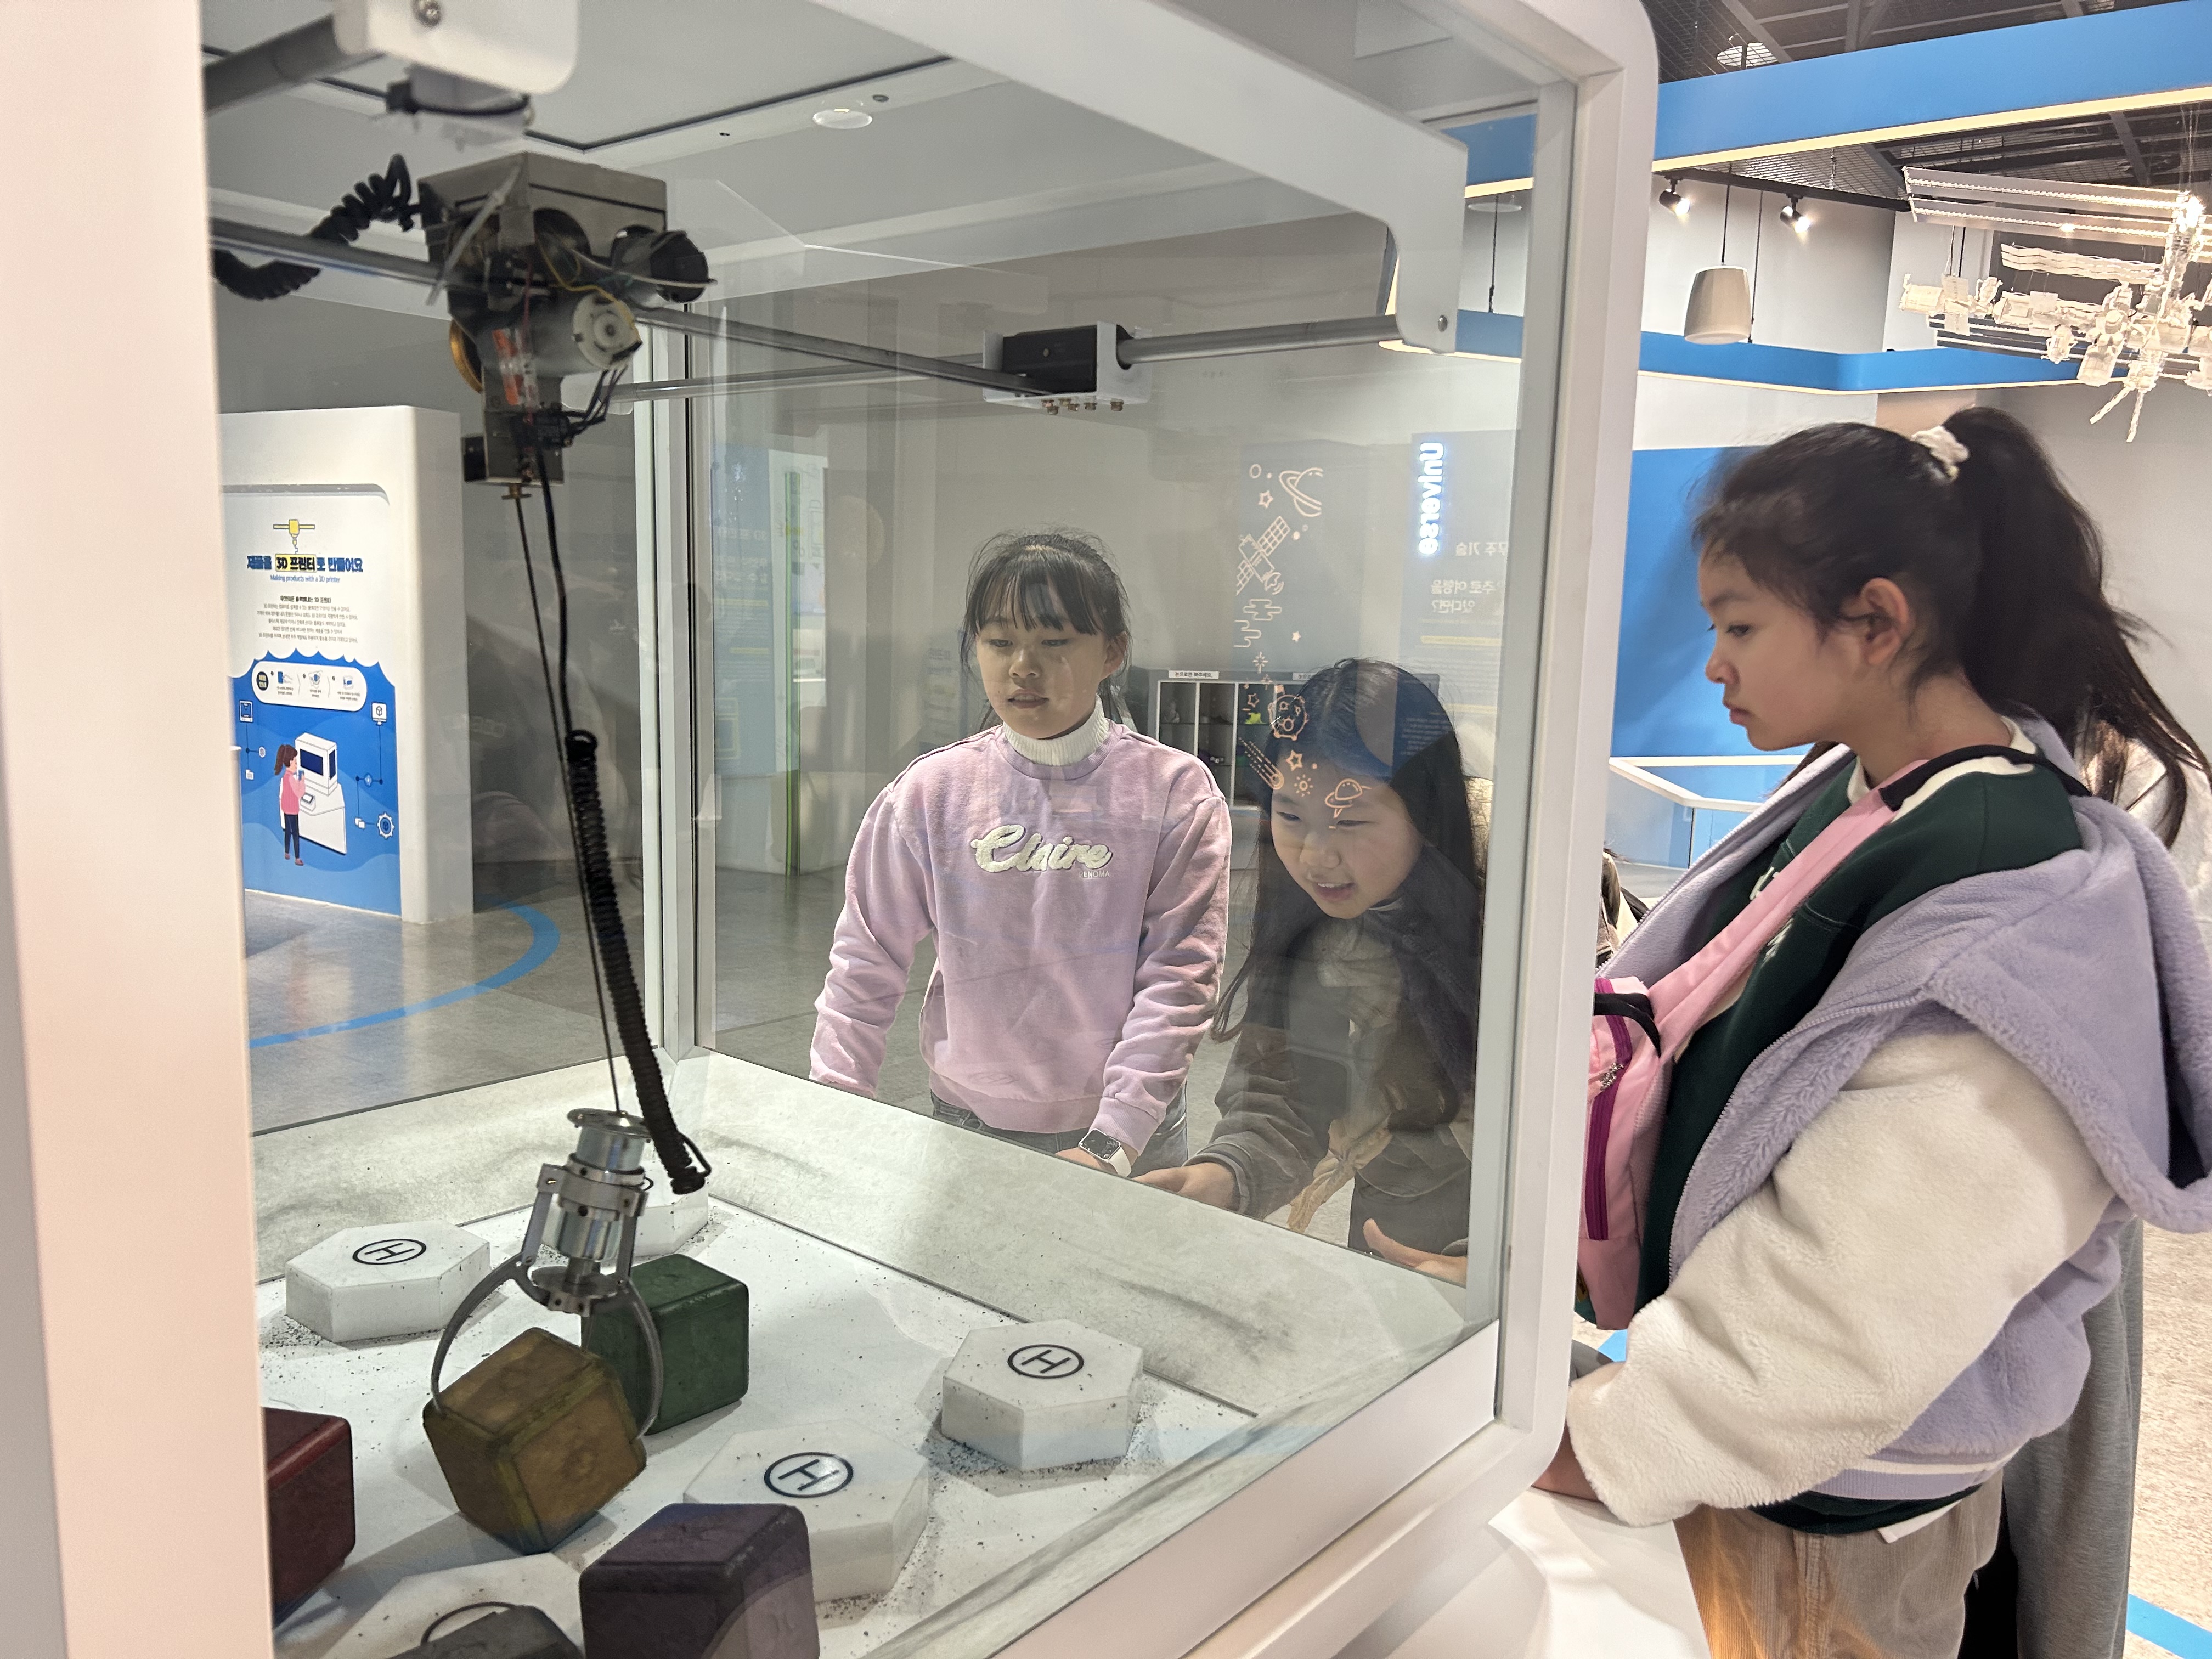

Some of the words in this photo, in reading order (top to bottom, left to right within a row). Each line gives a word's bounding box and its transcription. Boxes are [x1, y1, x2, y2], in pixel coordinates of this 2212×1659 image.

[276, 557, 287, 569] 3D
[970, 824, 1114, 873] Claire
[1079, 870, 1110, 878] RENOMA
[364, 1243, 404, 1261] H
[1021, 1348, 1071, 1373] H
[778, 1459, 839, 1491] H
